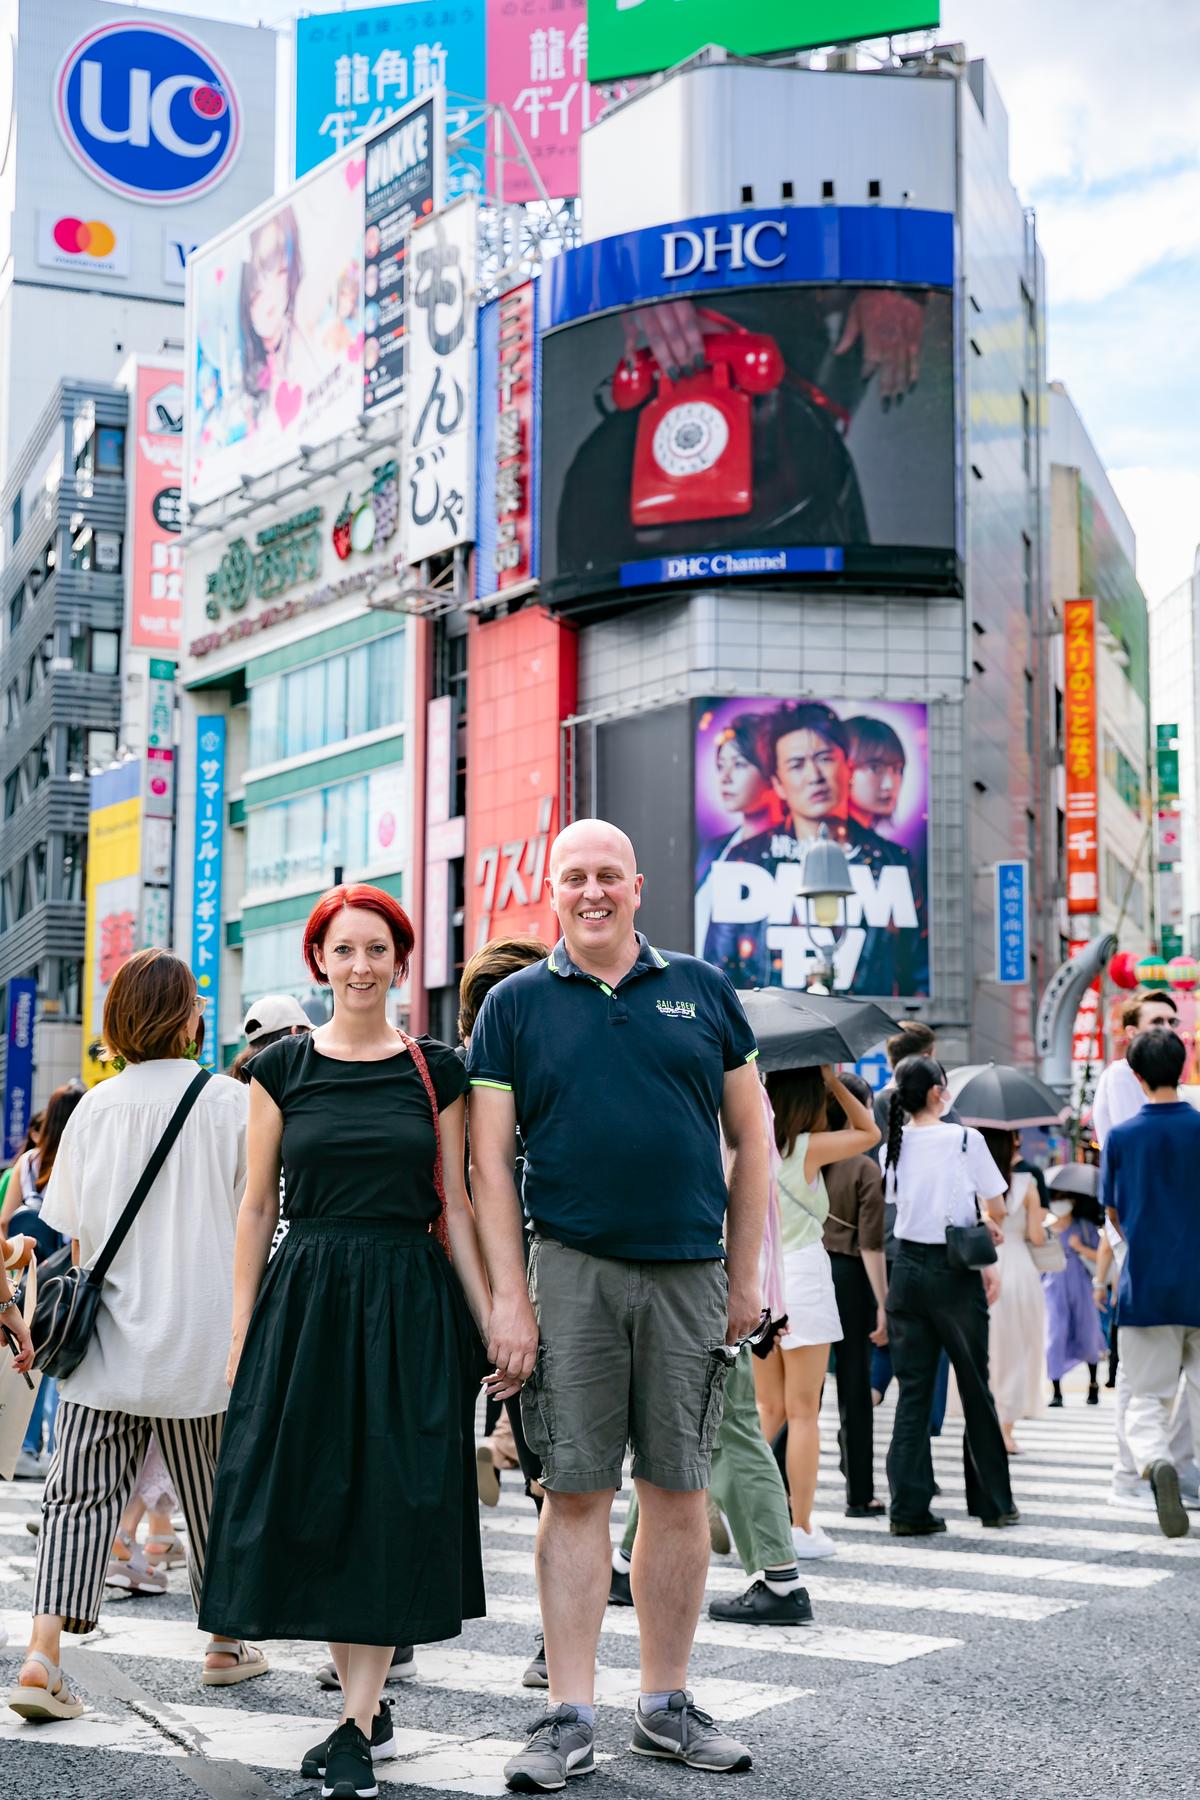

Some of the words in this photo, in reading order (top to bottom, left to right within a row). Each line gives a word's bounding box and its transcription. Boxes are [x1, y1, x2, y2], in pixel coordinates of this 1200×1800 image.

[661, 220, 788, 279] DHC
[668, 556, 709, 578] DHC
[711, 551, 787, 574] Channel
[1068, 606, 1093, 779] クスリのことなら
[197, 758, 219, 968] サマーフルーツギフト
[656, 999, 675, 1008] SAIL
[675, 1001, 696, 1011] CREW
